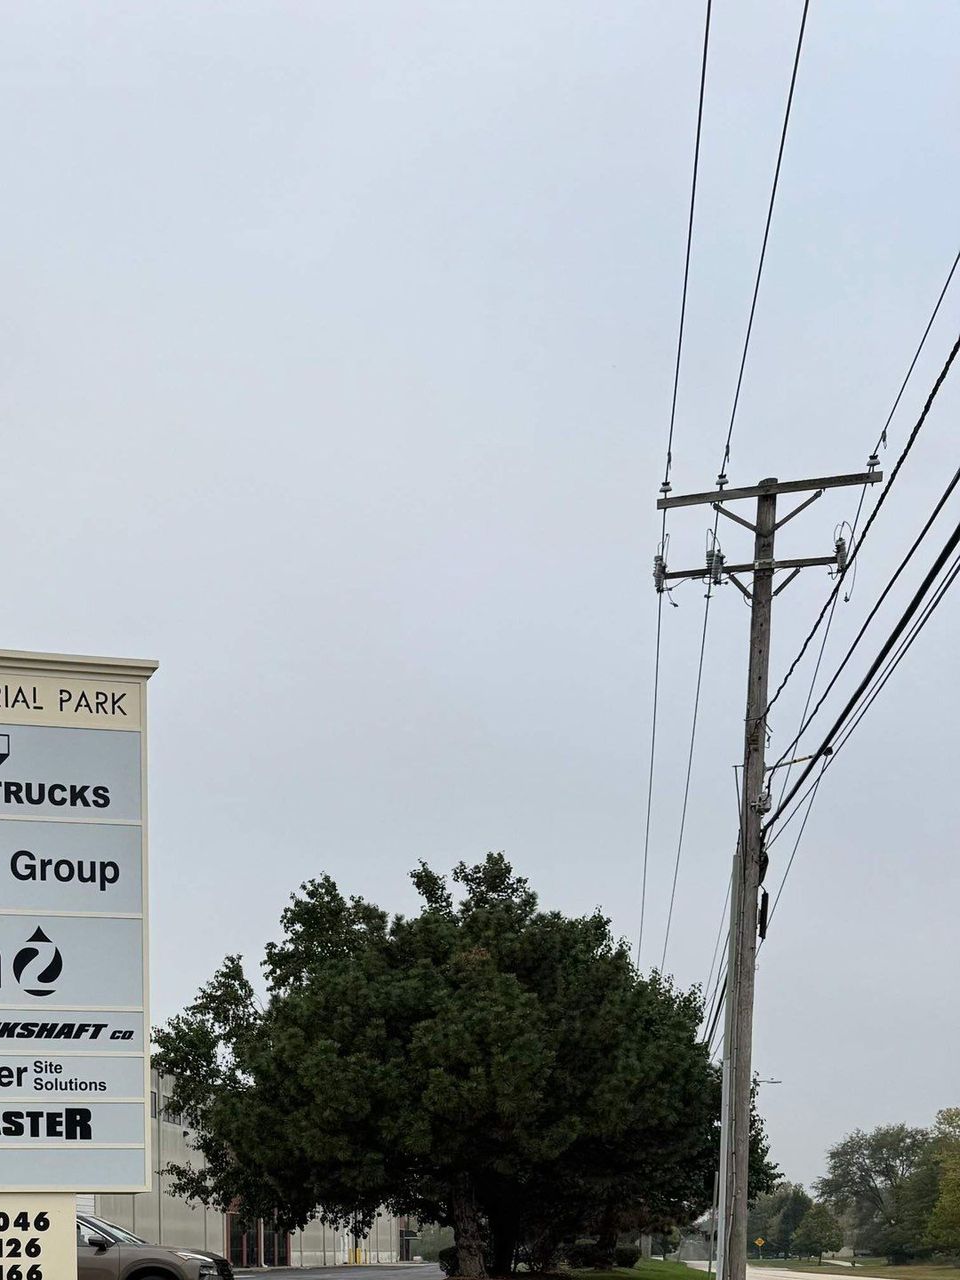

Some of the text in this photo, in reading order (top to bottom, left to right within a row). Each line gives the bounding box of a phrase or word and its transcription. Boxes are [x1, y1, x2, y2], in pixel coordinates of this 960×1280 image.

[59, 688, 128, 716] PARK
[10, 850, 120, 892] Group
[33, 1060, 64, 1075] Site
[33, 1077, 107, 1092] Solutions
